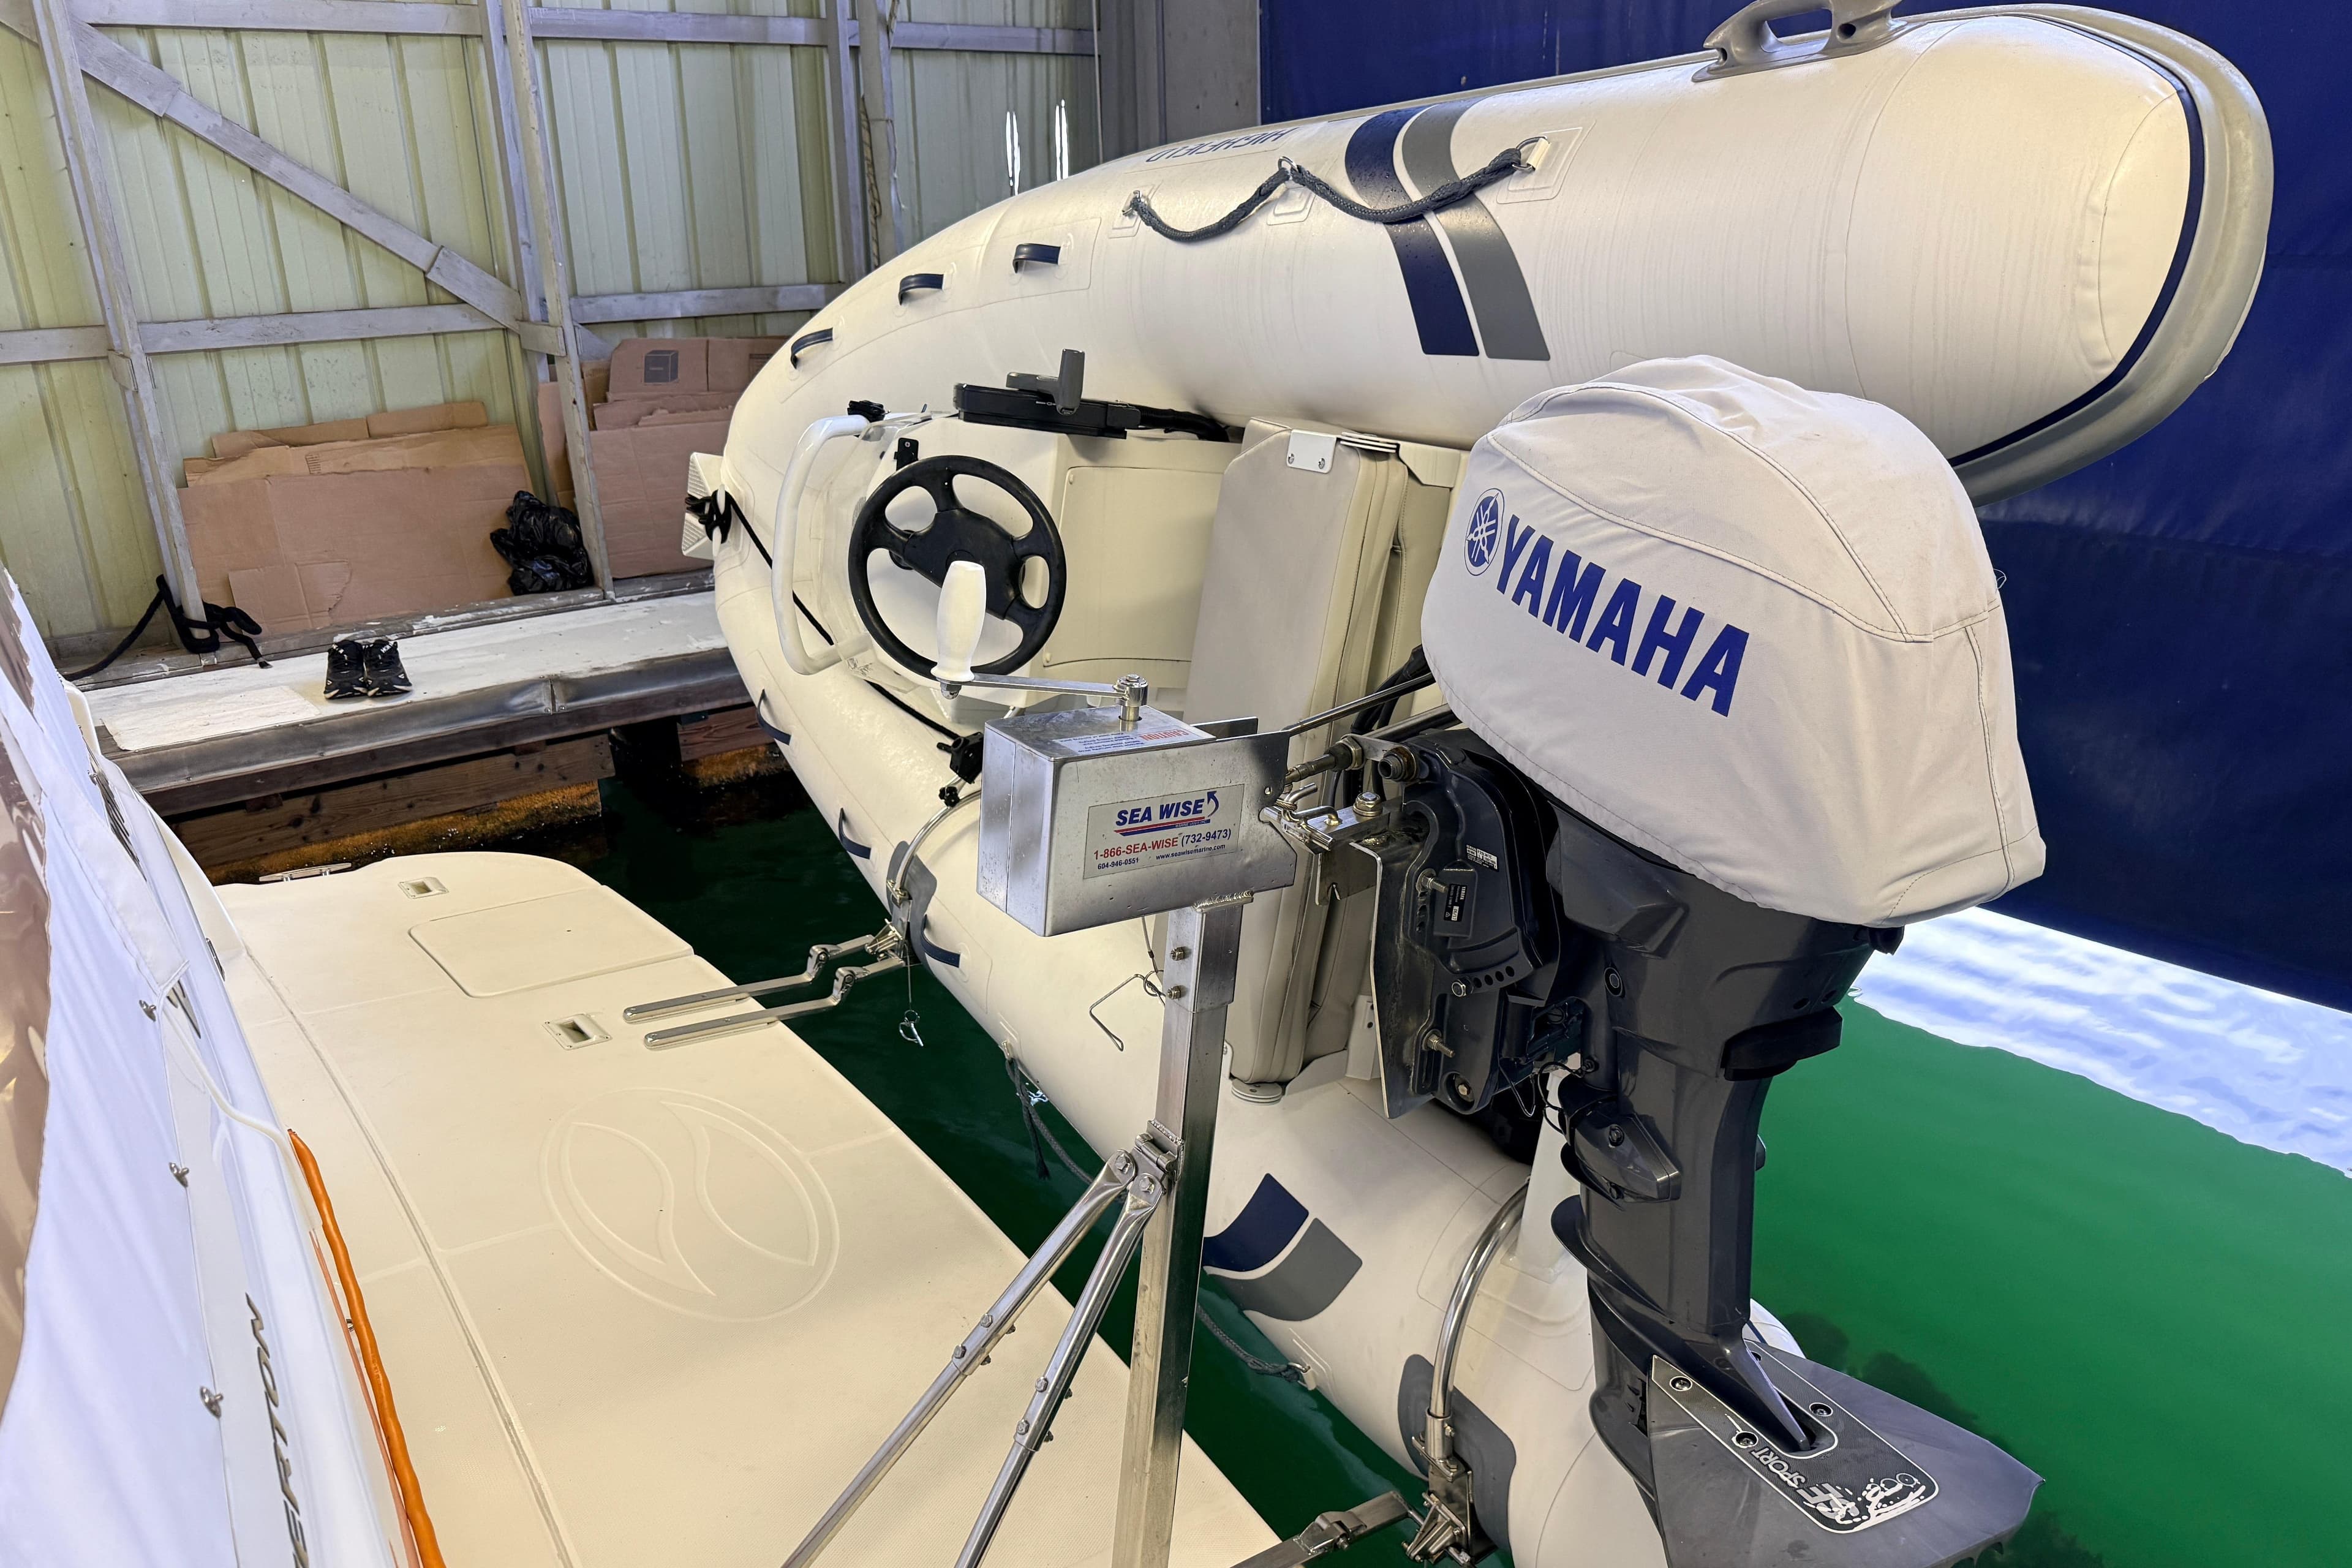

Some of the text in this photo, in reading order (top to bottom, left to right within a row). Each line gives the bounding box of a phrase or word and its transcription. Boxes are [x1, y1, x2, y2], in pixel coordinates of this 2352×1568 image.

[1146, 127, 1299, 162] HIGHFIELD
[1496, 514, 1749, 717] YAMAHA
[1139, 729, 1190, 741] CAUTION
[1115, 799, 1205, 826] SEA WISE
[1093, 828, 1232, 860] 1-866-SEA-WISE (732-9473)
[1098, 843, 1226, 870] 604-946-0551 www.seawisemarine.com
[245, 1292, 309, 1568] ERTON
[1751, 1447, 1806, 1488] SPORT
